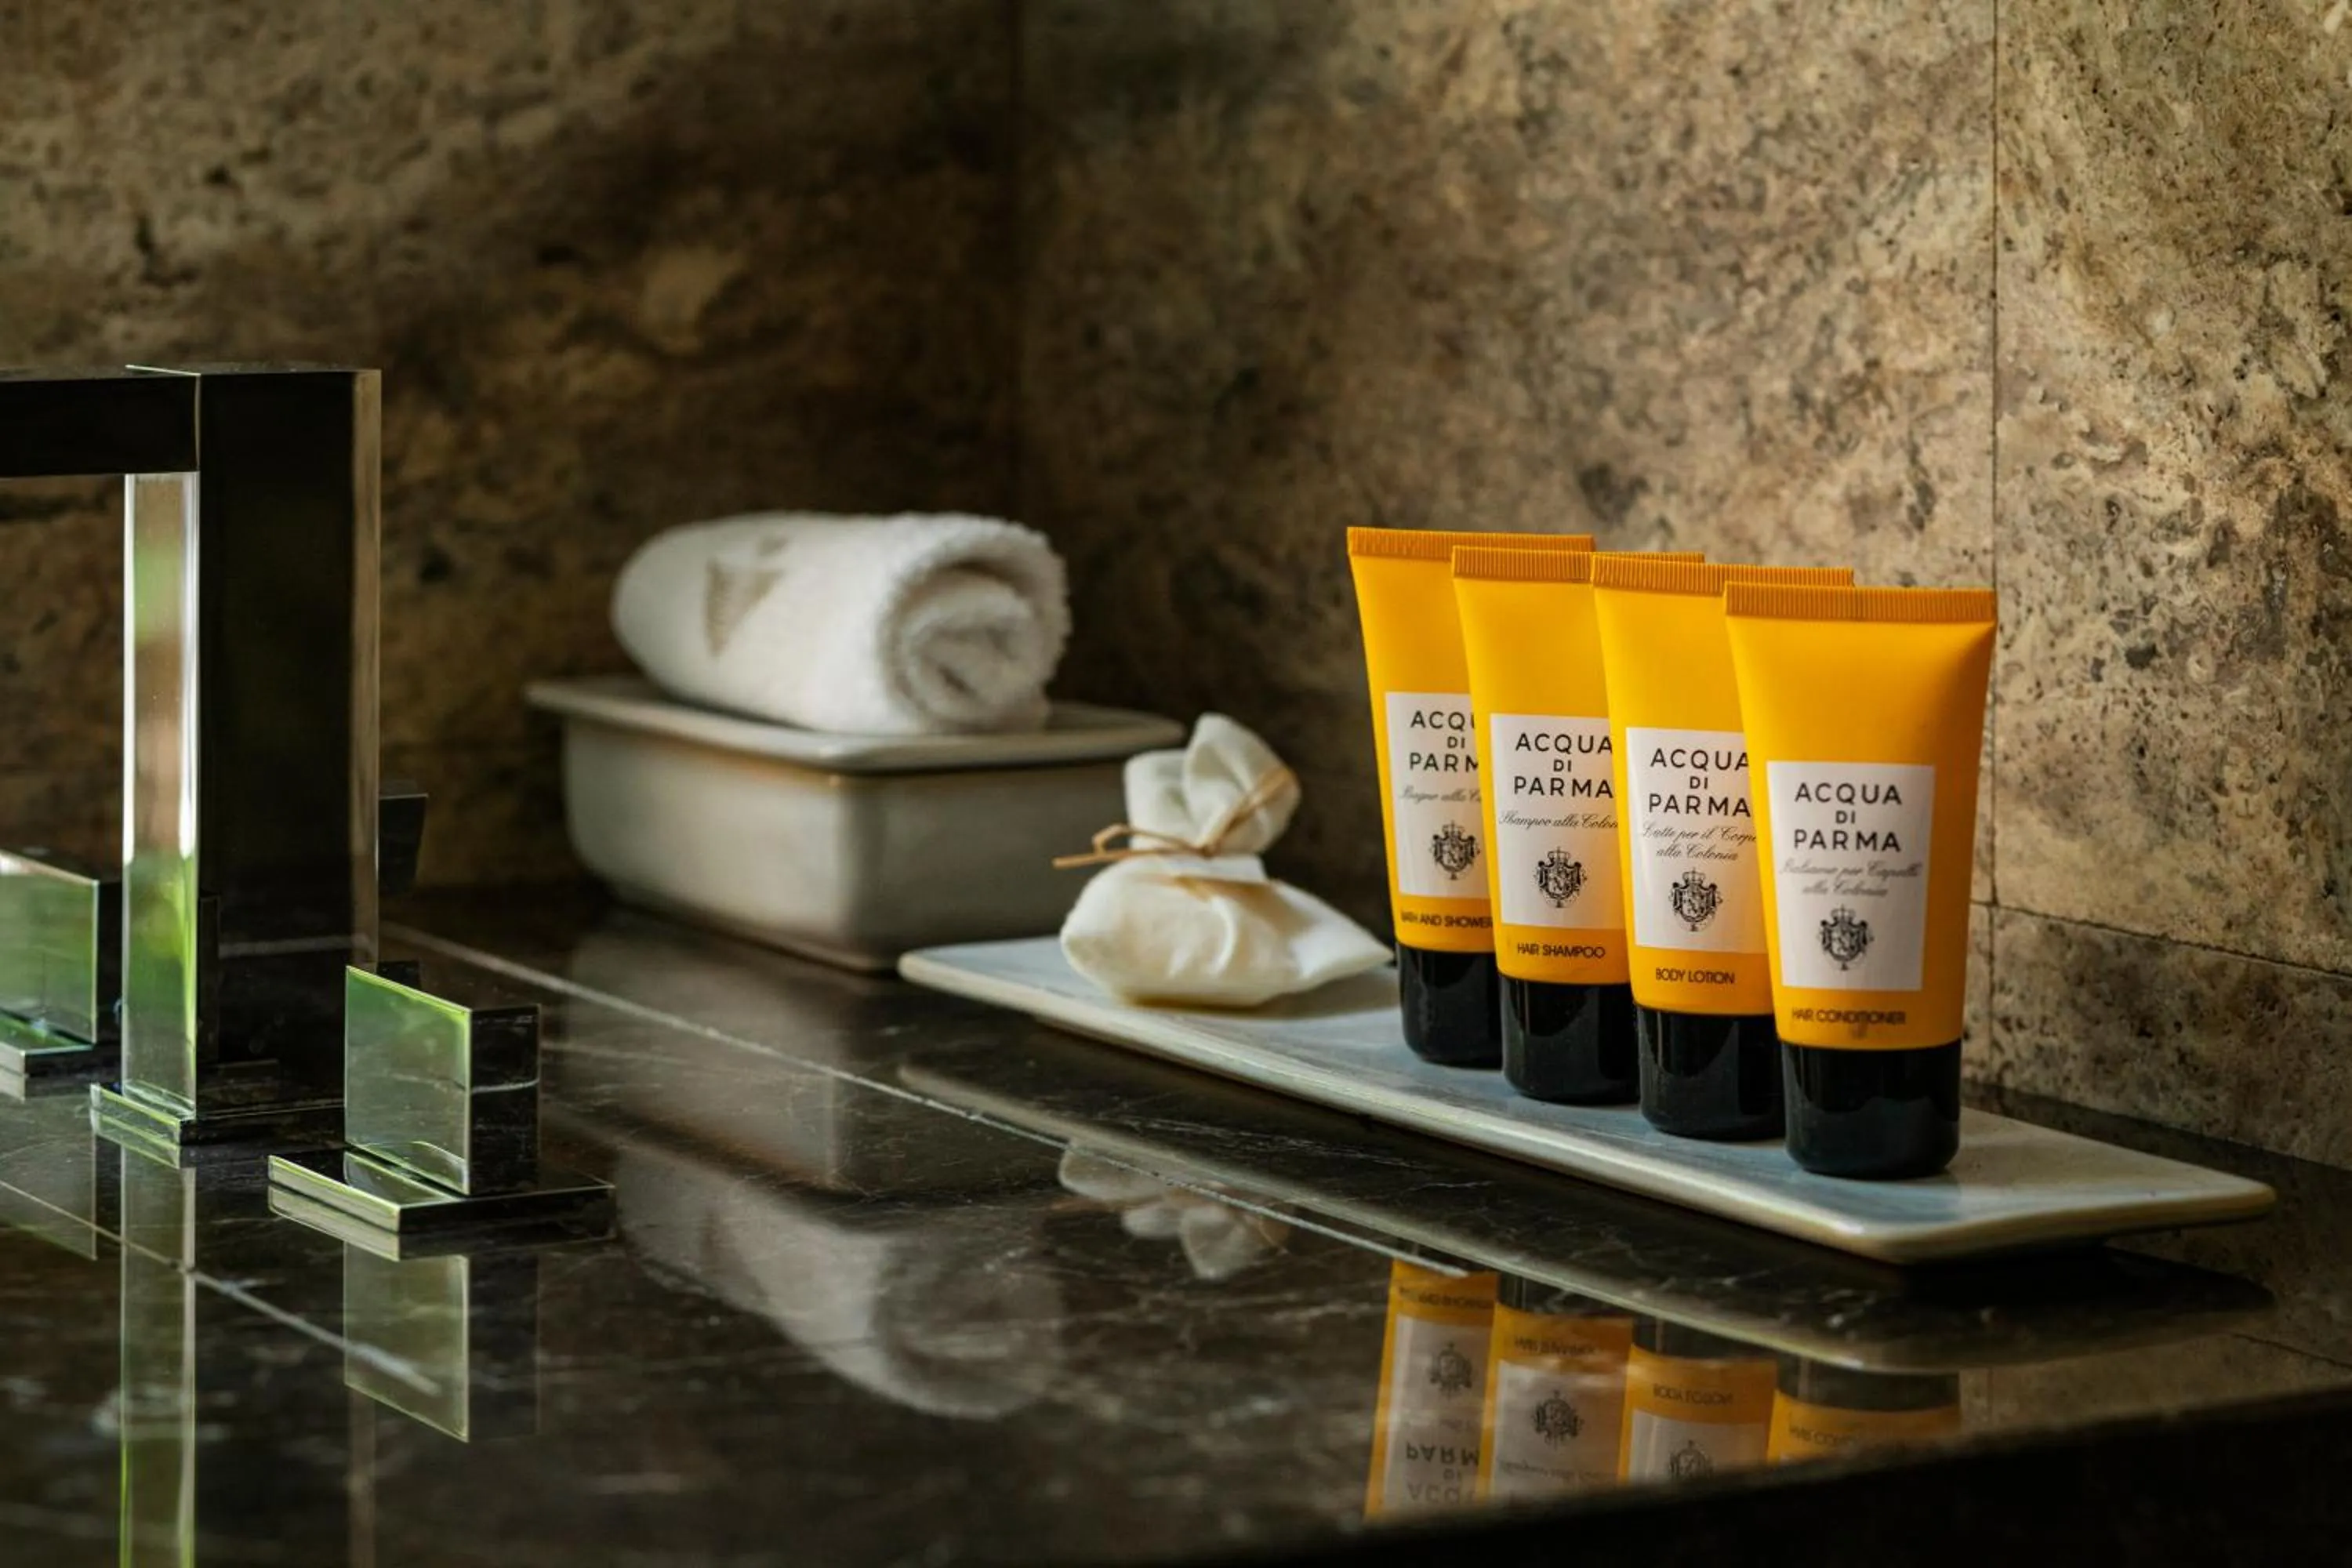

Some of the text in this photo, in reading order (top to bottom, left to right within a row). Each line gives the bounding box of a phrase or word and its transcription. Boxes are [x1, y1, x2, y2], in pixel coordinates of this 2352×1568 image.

[1410, 710, 1476, 731] ACQ
[1446, 736, 1465, 750] DI
[1515, 732, 1613, 755] ACQUA
[1409, 752, 1479, 773] PARM
[1552, 759, 1572, 773] DI
[1650, 747, 1749, 771] ACQUA
[1513, 775, 1614, 799] PARMA
[1689, 775, 1708, 790] DI
[1794, 782, 1903, 805] ACQUA
[1648, 793, 1751, 818] PARMA
[1835, 810, 1857, 825] DI
[1793, 829, 1902, 853] PARMA
[1655, 842, 1739, 862] alla Colonia
[1419, 913, 1443, 927] AND
[1517, 942, 1606, 960] HAIR SHAMPOO
[1655, 967, 1736, 985] BODY LOTION
